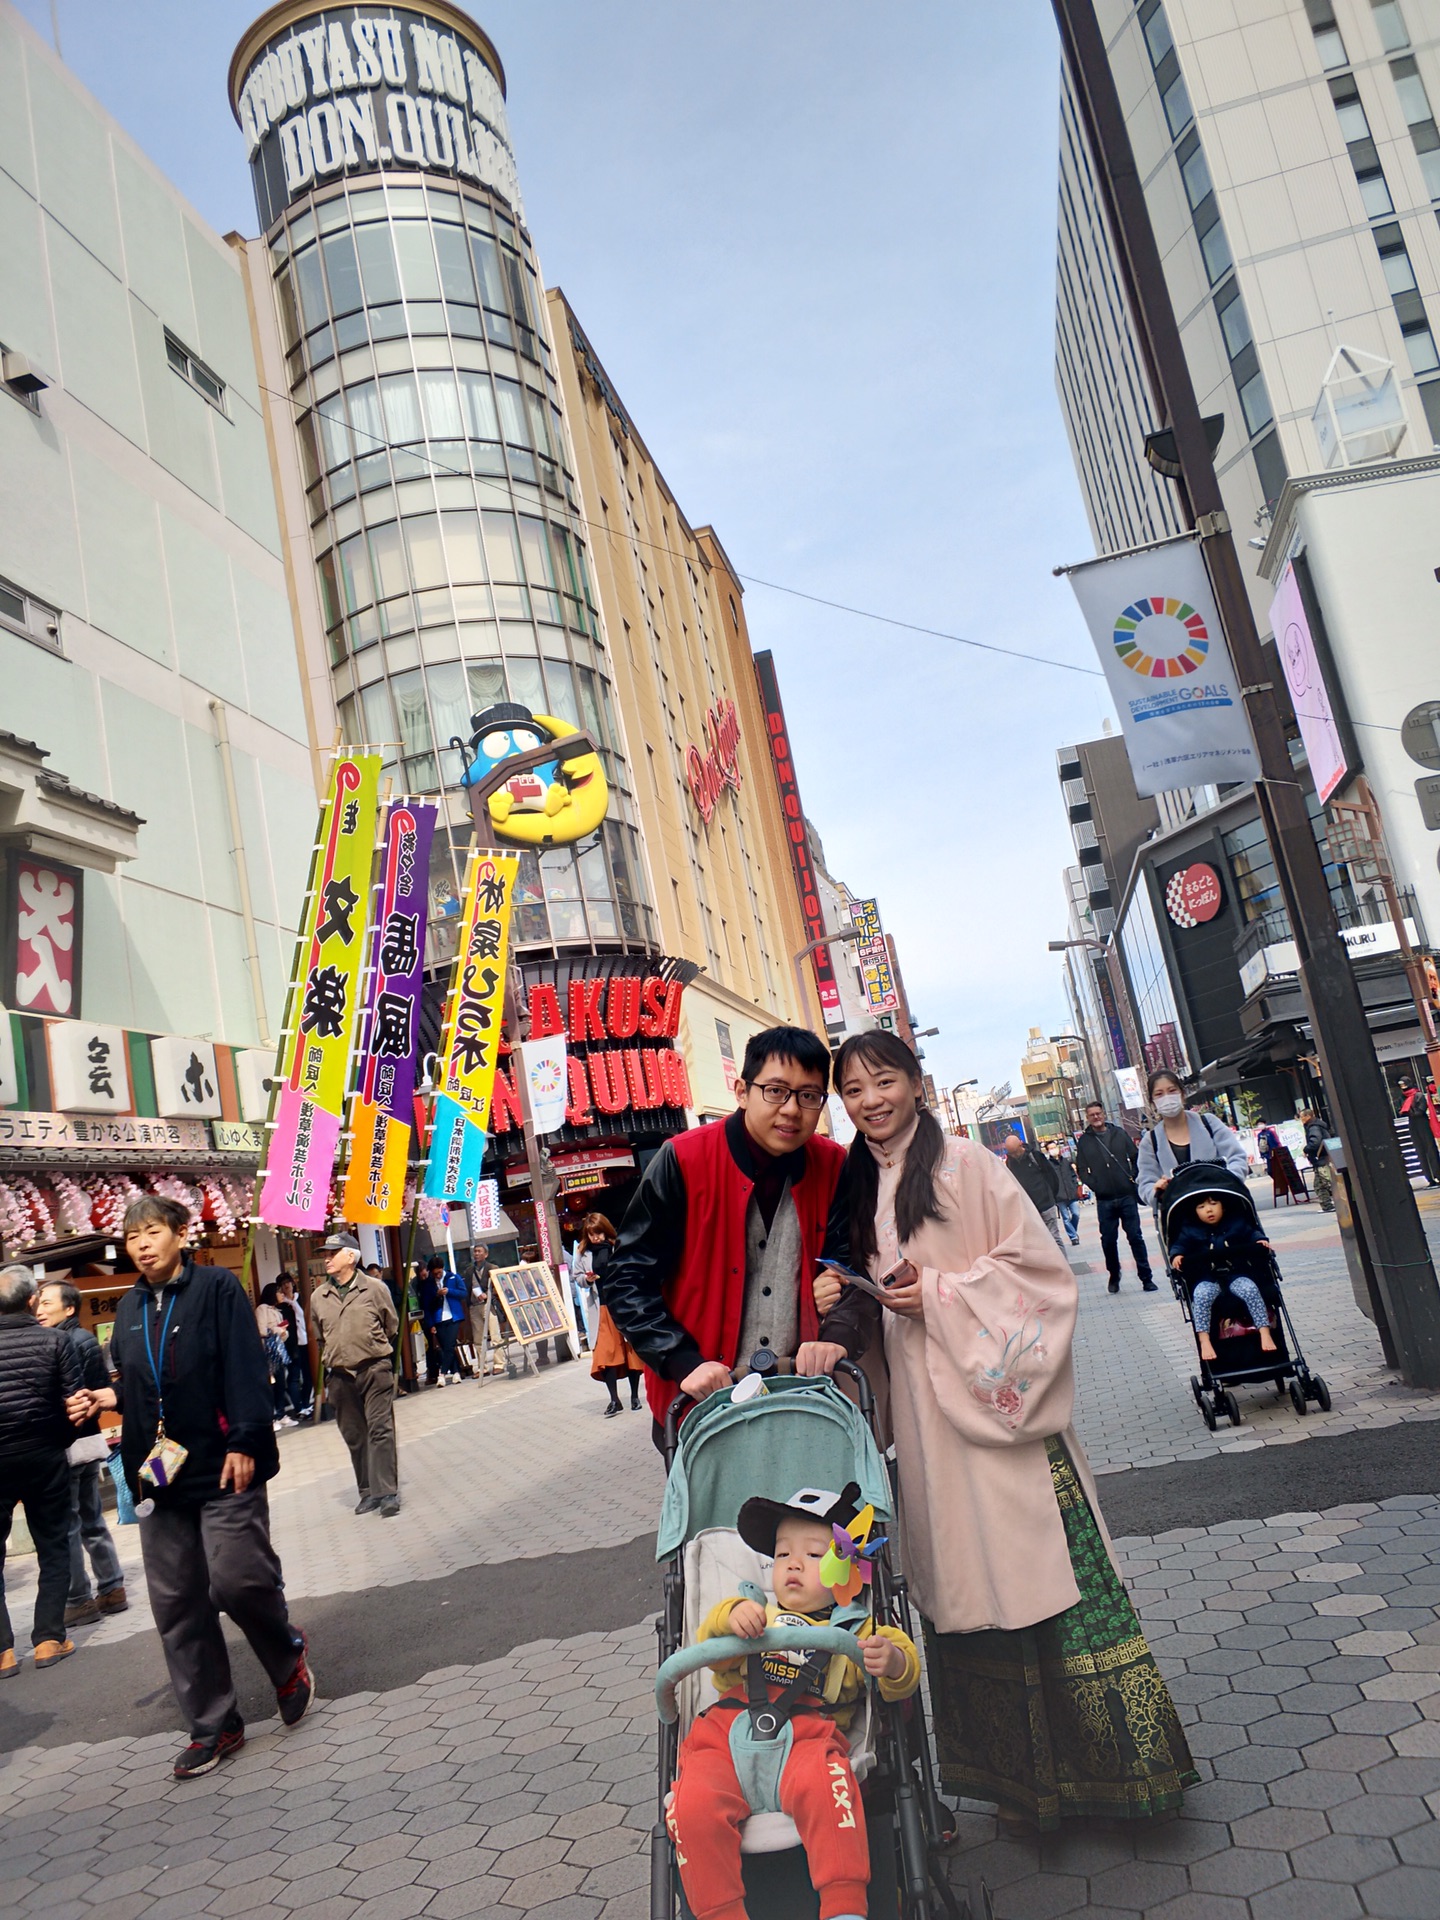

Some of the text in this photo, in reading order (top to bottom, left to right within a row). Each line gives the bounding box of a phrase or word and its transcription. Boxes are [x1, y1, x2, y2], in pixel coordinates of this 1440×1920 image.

[409, 22, 468, 105] NO
[1128, 689, 1178, 708] SUSTAINABLE
[1179, 684, 1229, 700] GOALS
[1130, 695, 1179, 714] DEVELOPMENT
[1185, 875, 1214, 896] まるごと
[1188, 889, 1218, 909] にっぽん
[478, 1184, 492, 1229] 六区花道
